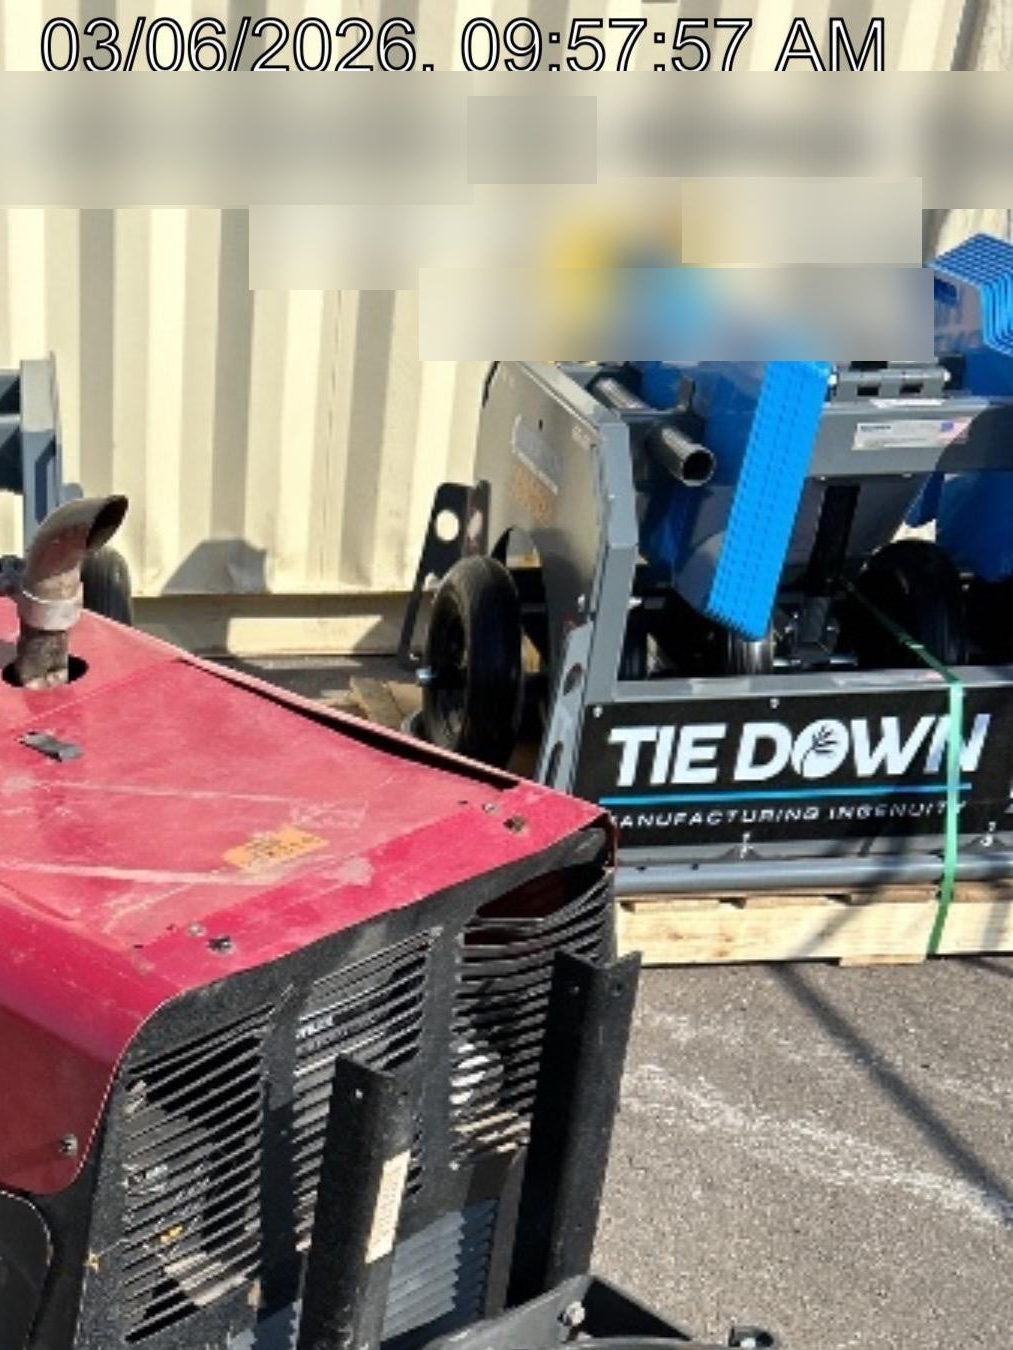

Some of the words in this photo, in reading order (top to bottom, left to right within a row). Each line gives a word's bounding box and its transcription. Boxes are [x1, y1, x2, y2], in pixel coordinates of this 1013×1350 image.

[607, 722, 728, 788] TIE
[733, 713, 992, 783] DOWN
[828, 800, 966, 821] INGENUITY
